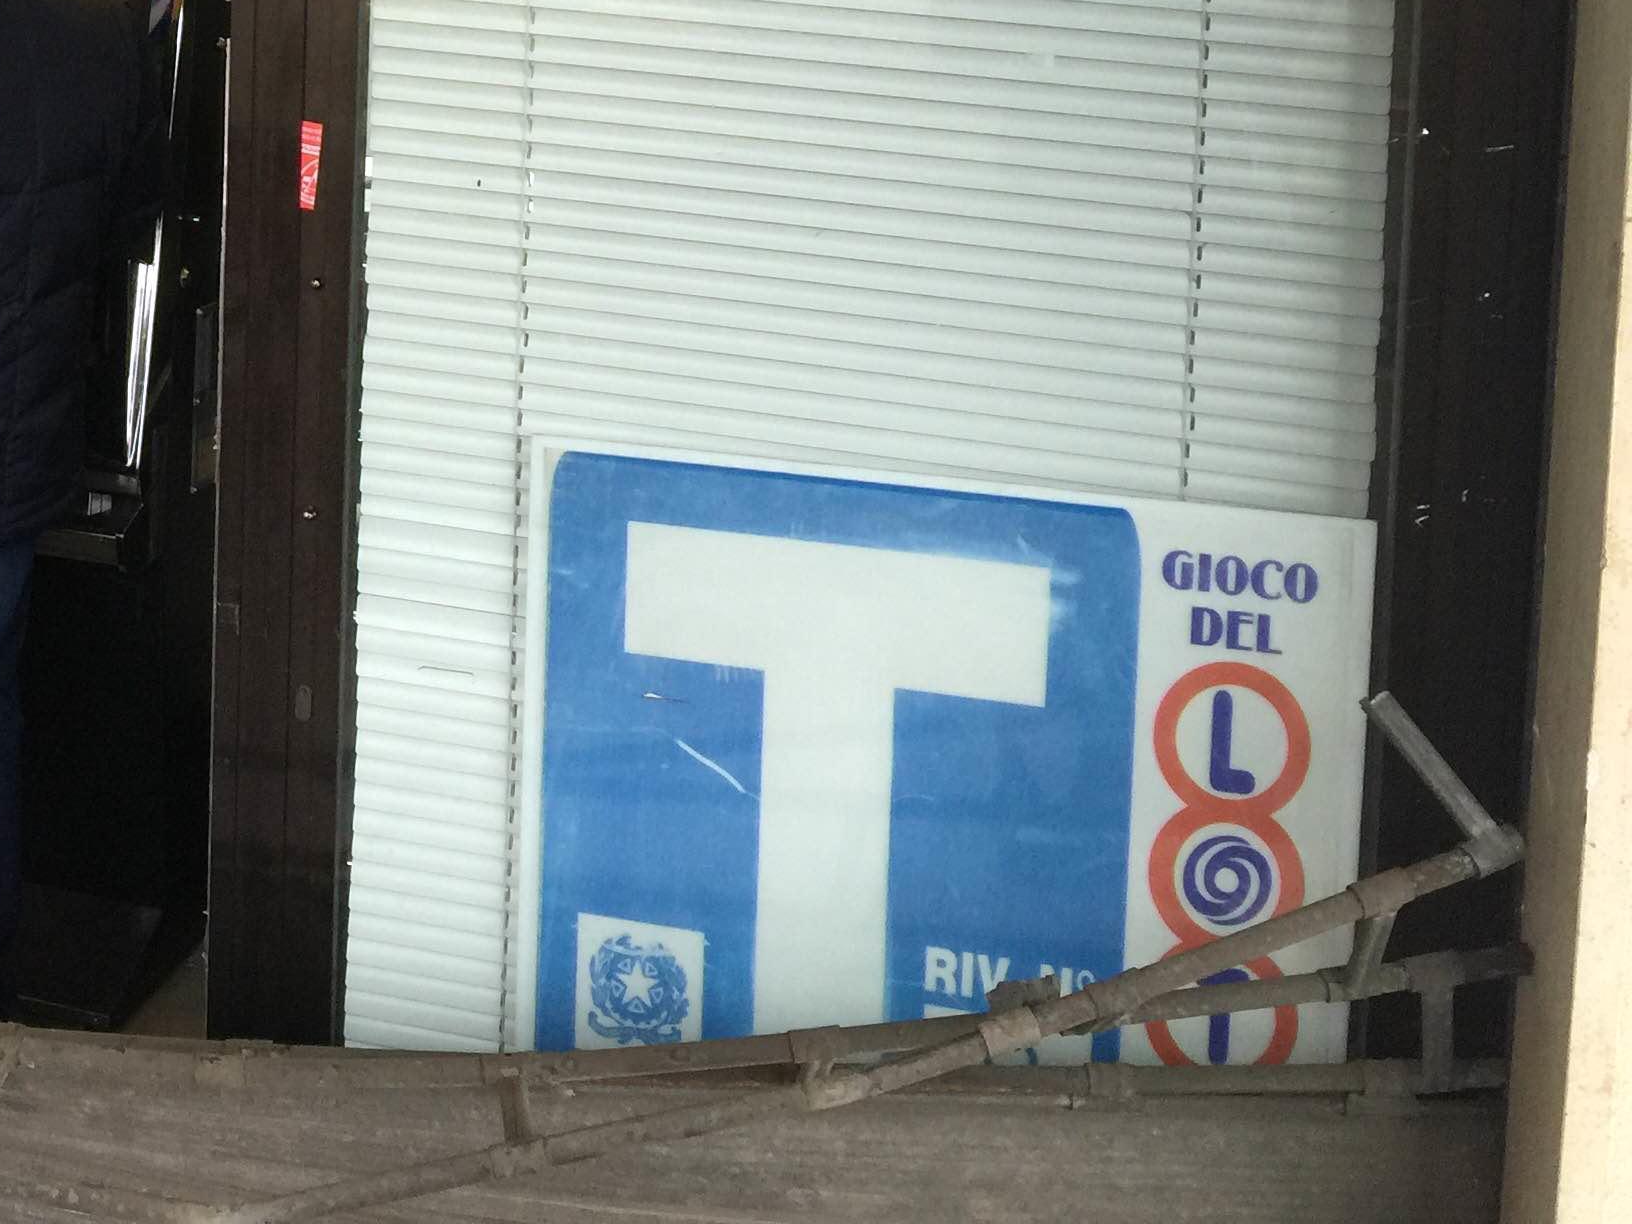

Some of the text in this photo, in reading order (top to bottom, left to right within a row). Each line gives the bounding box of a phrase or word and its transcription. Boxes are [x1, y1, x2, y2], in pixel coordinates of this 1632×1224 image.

[1161, 549, 1319, 605] GIOCO
[1190, 606, 1283, 656] DEL
[624, 520, 1052, 1038] T
